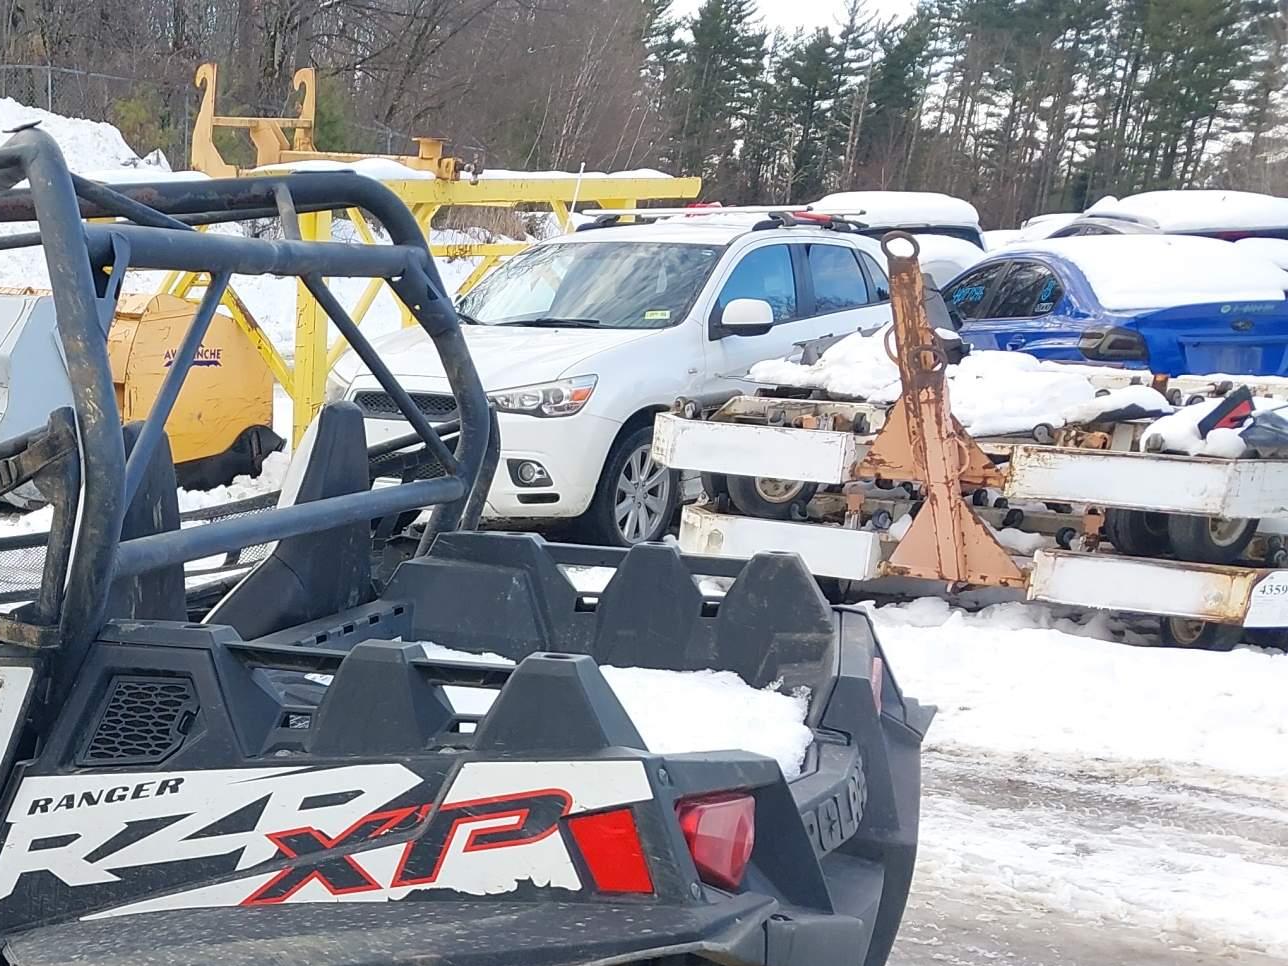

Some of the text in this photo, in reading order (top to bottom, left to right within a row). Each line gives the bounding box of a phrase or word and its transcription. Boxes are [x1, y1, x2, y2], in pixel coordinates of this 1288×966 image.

[163, 348, 223, 360] AVNCHE
[27, 776, 185, 815] RANGER
[240, 788, 574, 907] XP
